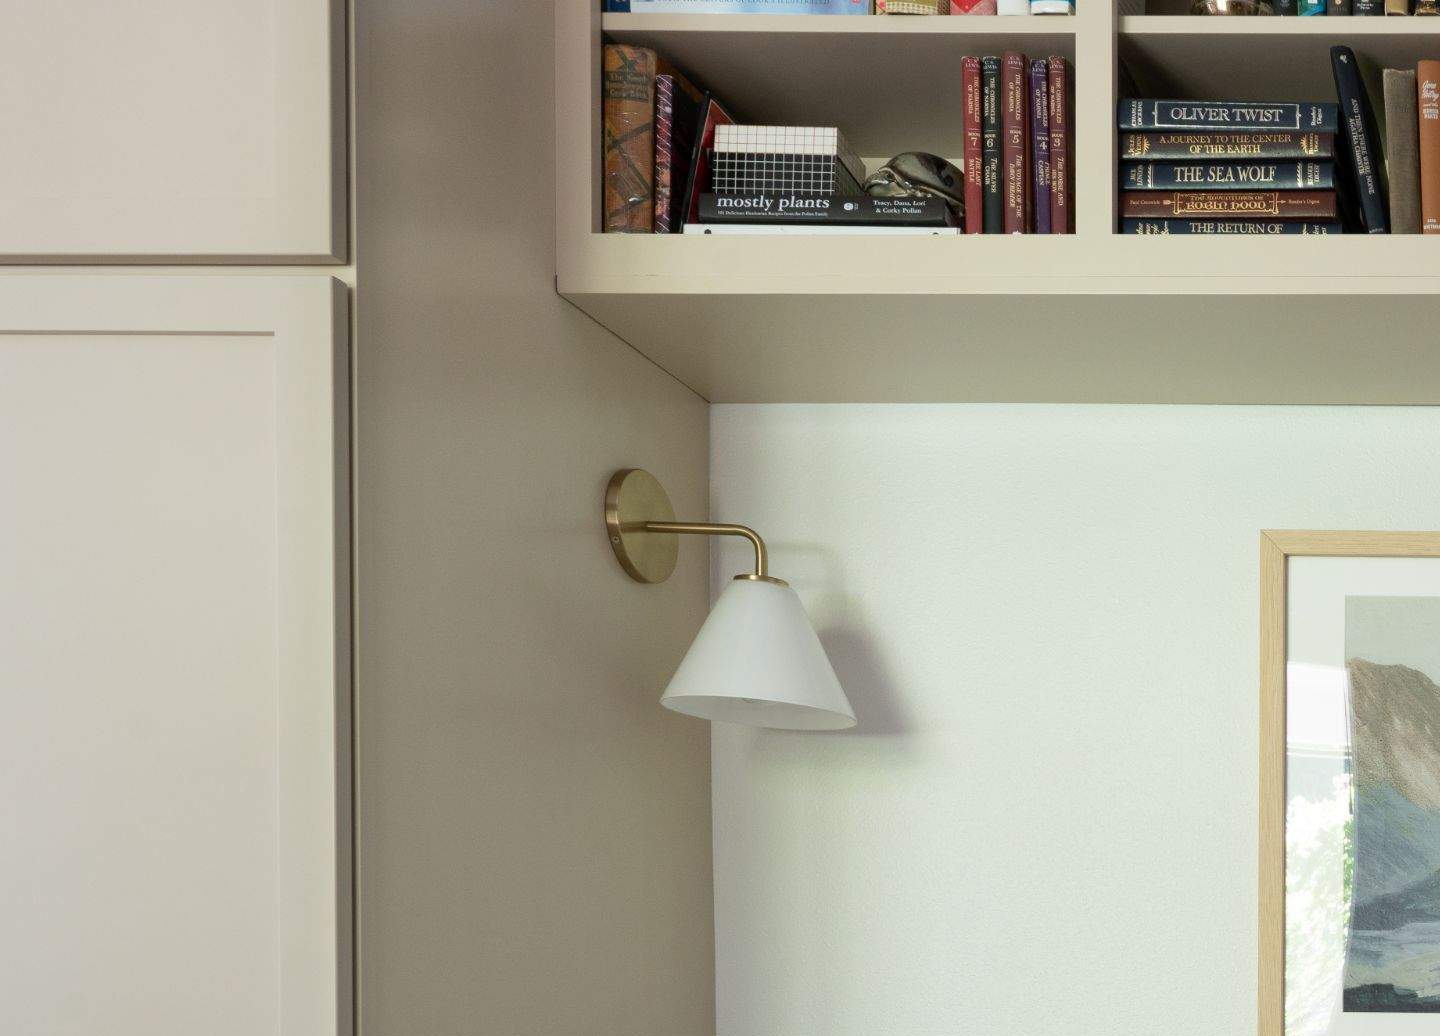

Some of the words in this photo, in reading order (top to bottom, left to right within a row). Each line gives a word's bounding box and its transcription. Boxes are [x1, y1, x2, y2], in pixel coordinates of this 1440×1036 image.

[1351, 98, 1360, 113] AND
[1170, 106, 1231, 123] OLIVER
[1232, 108, 1283, 123] TWIST
[1353, 114, 1363, 132] THEN
[987, 138, 993, 148] 6
[1012, 135, 1020, 145] 5
[1040, 141, 1047, 150] 4
[1159, 136, 1166, 144] A
[1167, 135, 1212, 144] JOURNEY
[1214, 135, 1229, 143] TO
[1230, 134, 1250, 143] THE
[1253, 134, 1291, 143] CENTER
[1357, 133, 1366, 155] THERE
[1189, 145, 1202, 154] OF
[1204, 145, 1225, 154] THE
[1227, 144, 1261, 154] EARTH
[1349, 118, 1359, 144] AGATHA
[1354, 145, 1365, 176] CHRISTIE
[1361, 155, 1370, 174] WERE
[1173, 166, 1204, 182] THE
[1207, 166, 1235, 182] SEA
[1236, 166, 1277, 182] WOLF
[1365, 175, 1374, 195] NONE
[716, 195, 774, 212] mostly
[778, 195, 830, 212] plants
[1186, 201, 1227, 210] ROBIN
[1189, 222, 1214, 233] THE
[1217, 222, 1265, 233] RETURN
[1268, 222, 1283, 233] OF
